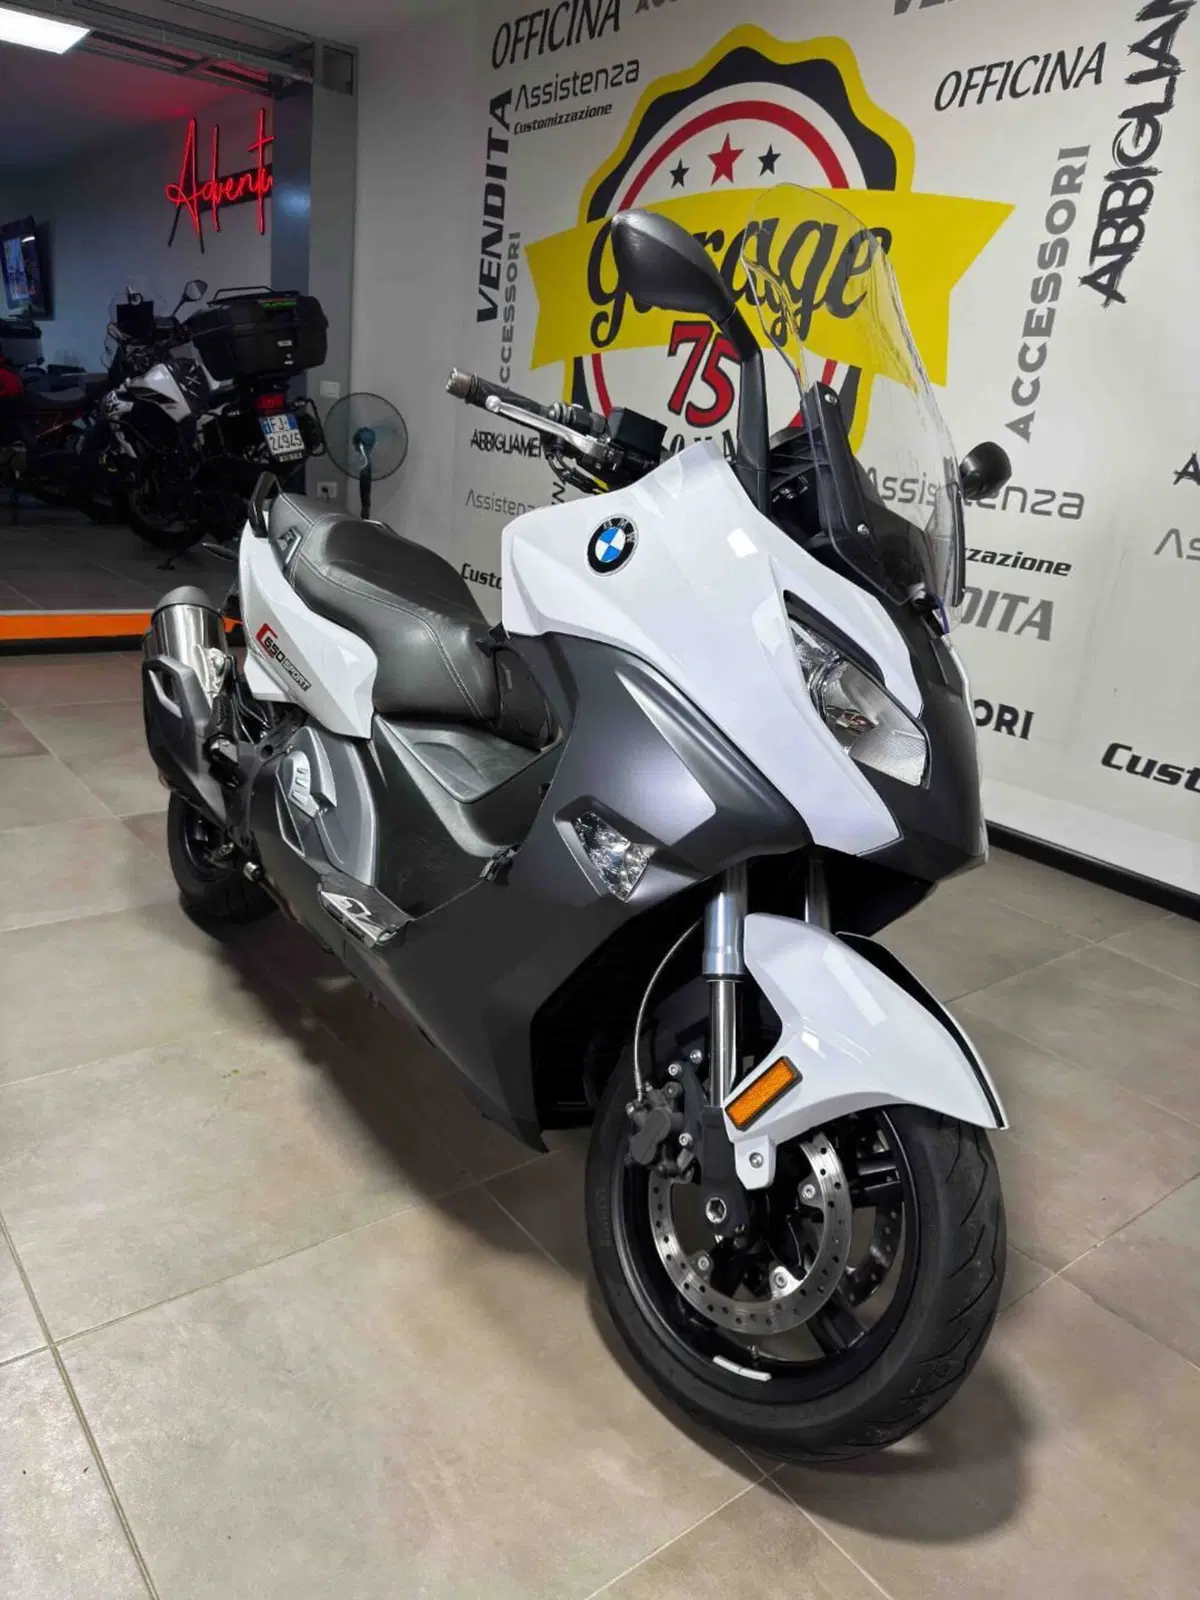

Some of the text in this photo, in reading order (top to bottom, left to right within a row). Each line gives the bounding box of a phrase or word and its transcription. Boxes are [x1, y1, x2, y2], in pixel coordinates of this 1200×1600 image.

[491, 0, 620, 69] OFFICINA
[514, 59, 640, 112] Assistenza
[934, 42, 1107, 111] OFFICINA
[513, 103, 613, 135] Customizzazione
[476, 88, 512, 323] VENDITA
[499, 231, 521, 388] CCESSORI
[1005, 144, 1091, 443] ACCESSORI
[667, 320, 741, 428] 75
[465, 488, 537, 516] Assisten
